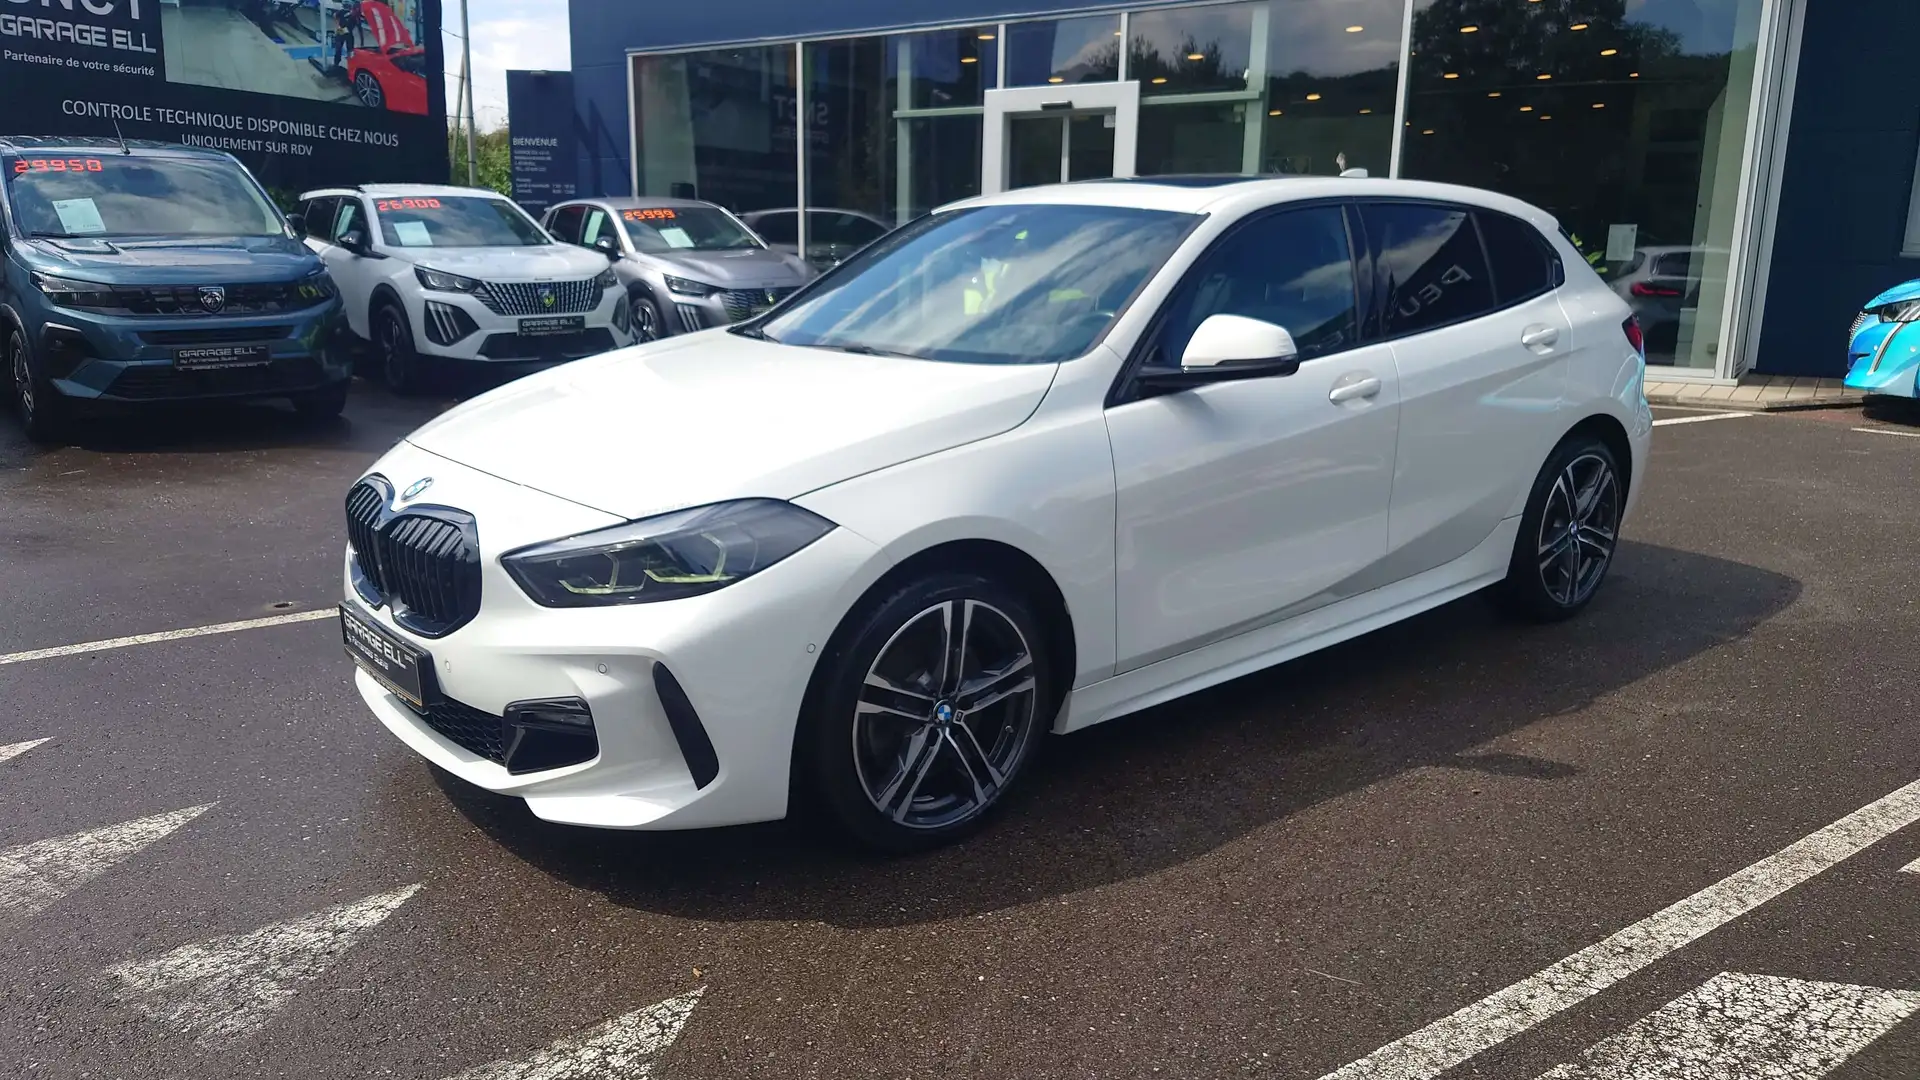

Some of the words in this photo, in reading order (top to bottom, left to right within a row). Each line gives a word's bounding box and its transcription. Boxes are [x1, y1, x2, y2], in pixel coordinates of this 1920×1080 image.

[0, 13, 108, 47] GARAGE
[112, 28, 157, 53] ELL
[4, 49, 63, 66] Partenaire
[66, 57, 80, 68] de
[82, 60, 110, 71] votre
[113, 63, 155, 76] sécurité
[62, 99, 152, 121] CONTROLE
[156, 108, 243, 130] TECHNIQUE
[247, 117, 326, 139] DISPONIBLE
[329, 126, 361, 143] CHEZ
[364, 131, 399, 147] NOUS
[181, 133, 263, 152] UNIQUEMENT
[265, 141, 288, 154] SUR
[291, 144, 313, 156] RDV
[512, 137, 558, 147] BIENVENUE
[14, 159, 103, 173] 29950
[377, 198, 441, 211] 26900
[623, 209, 676, 221] 25999
[180, 348, 232, 358] GARAGE
[234, 347, 257, 355] ELL
[344, 611, 383, 654] GARAGE
[383, 641, 407, 669] ELL
